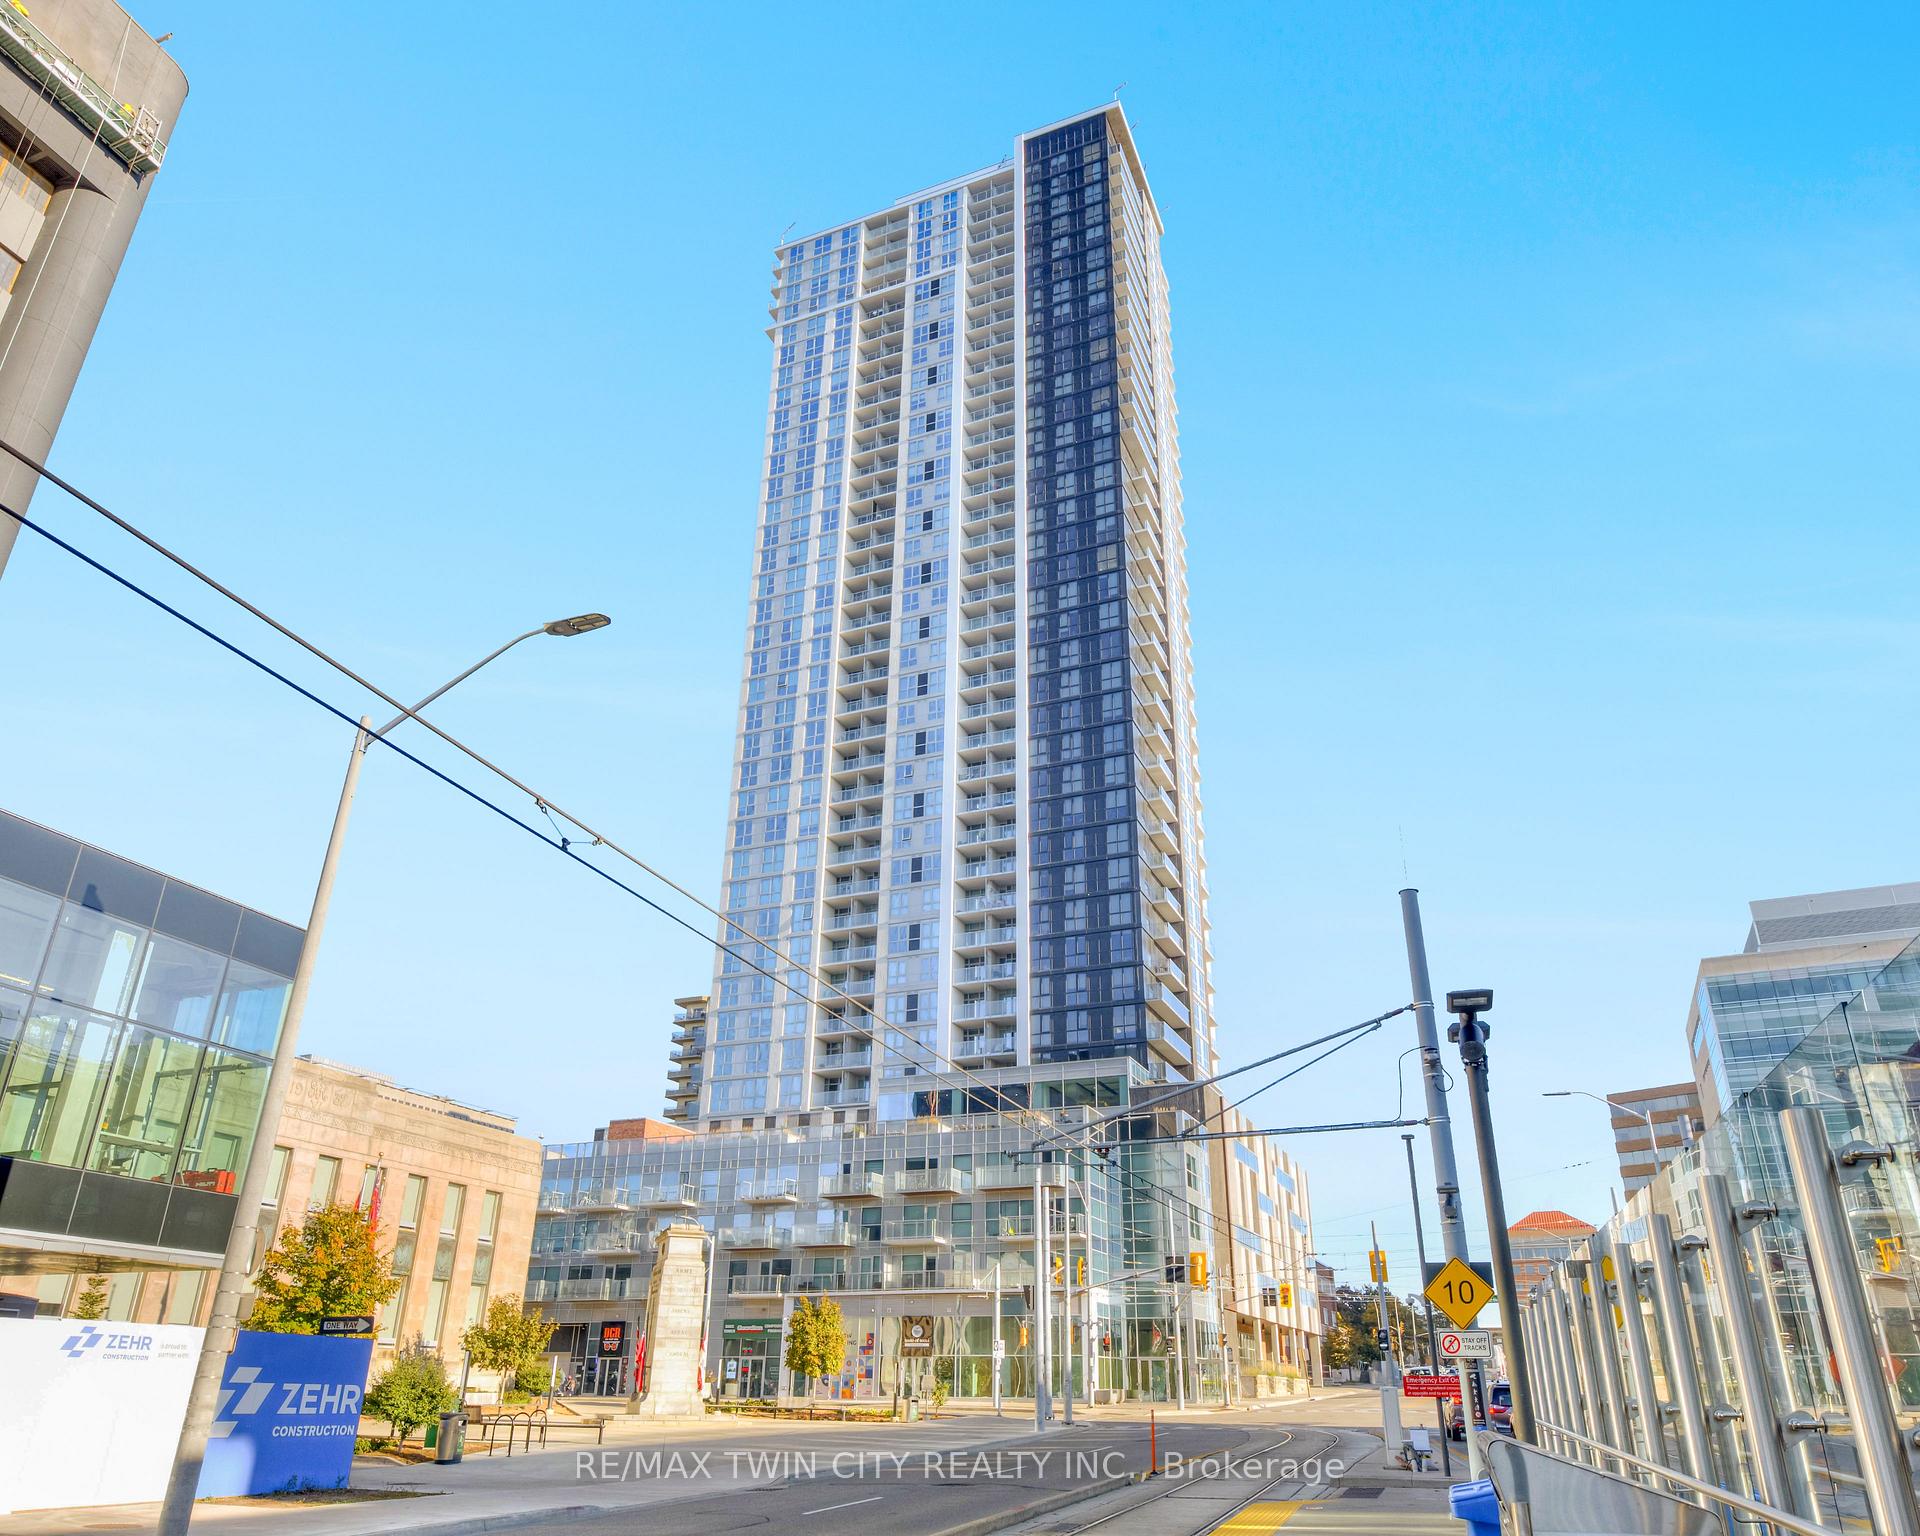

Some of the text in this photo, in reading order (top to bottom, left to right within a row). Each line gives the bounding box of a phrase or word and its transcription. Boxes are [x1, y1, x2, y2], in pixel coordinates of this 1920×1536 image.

[1443, 1280, 1474, 1305] 10
[325, 1321, 359, 1329] ONE WAY
[105, 1334, 153, 1351] ZEHR
[102, 1353, 149, 1361] CONSTRUCTION
[1405, 1376, 1438, 1384] Emergency
[1450, 1376, 1460, 1384] On
[276, 1383, 362, 1415] ZEHR
[272, 1425, 355, 1437] CONSTRUCTION
